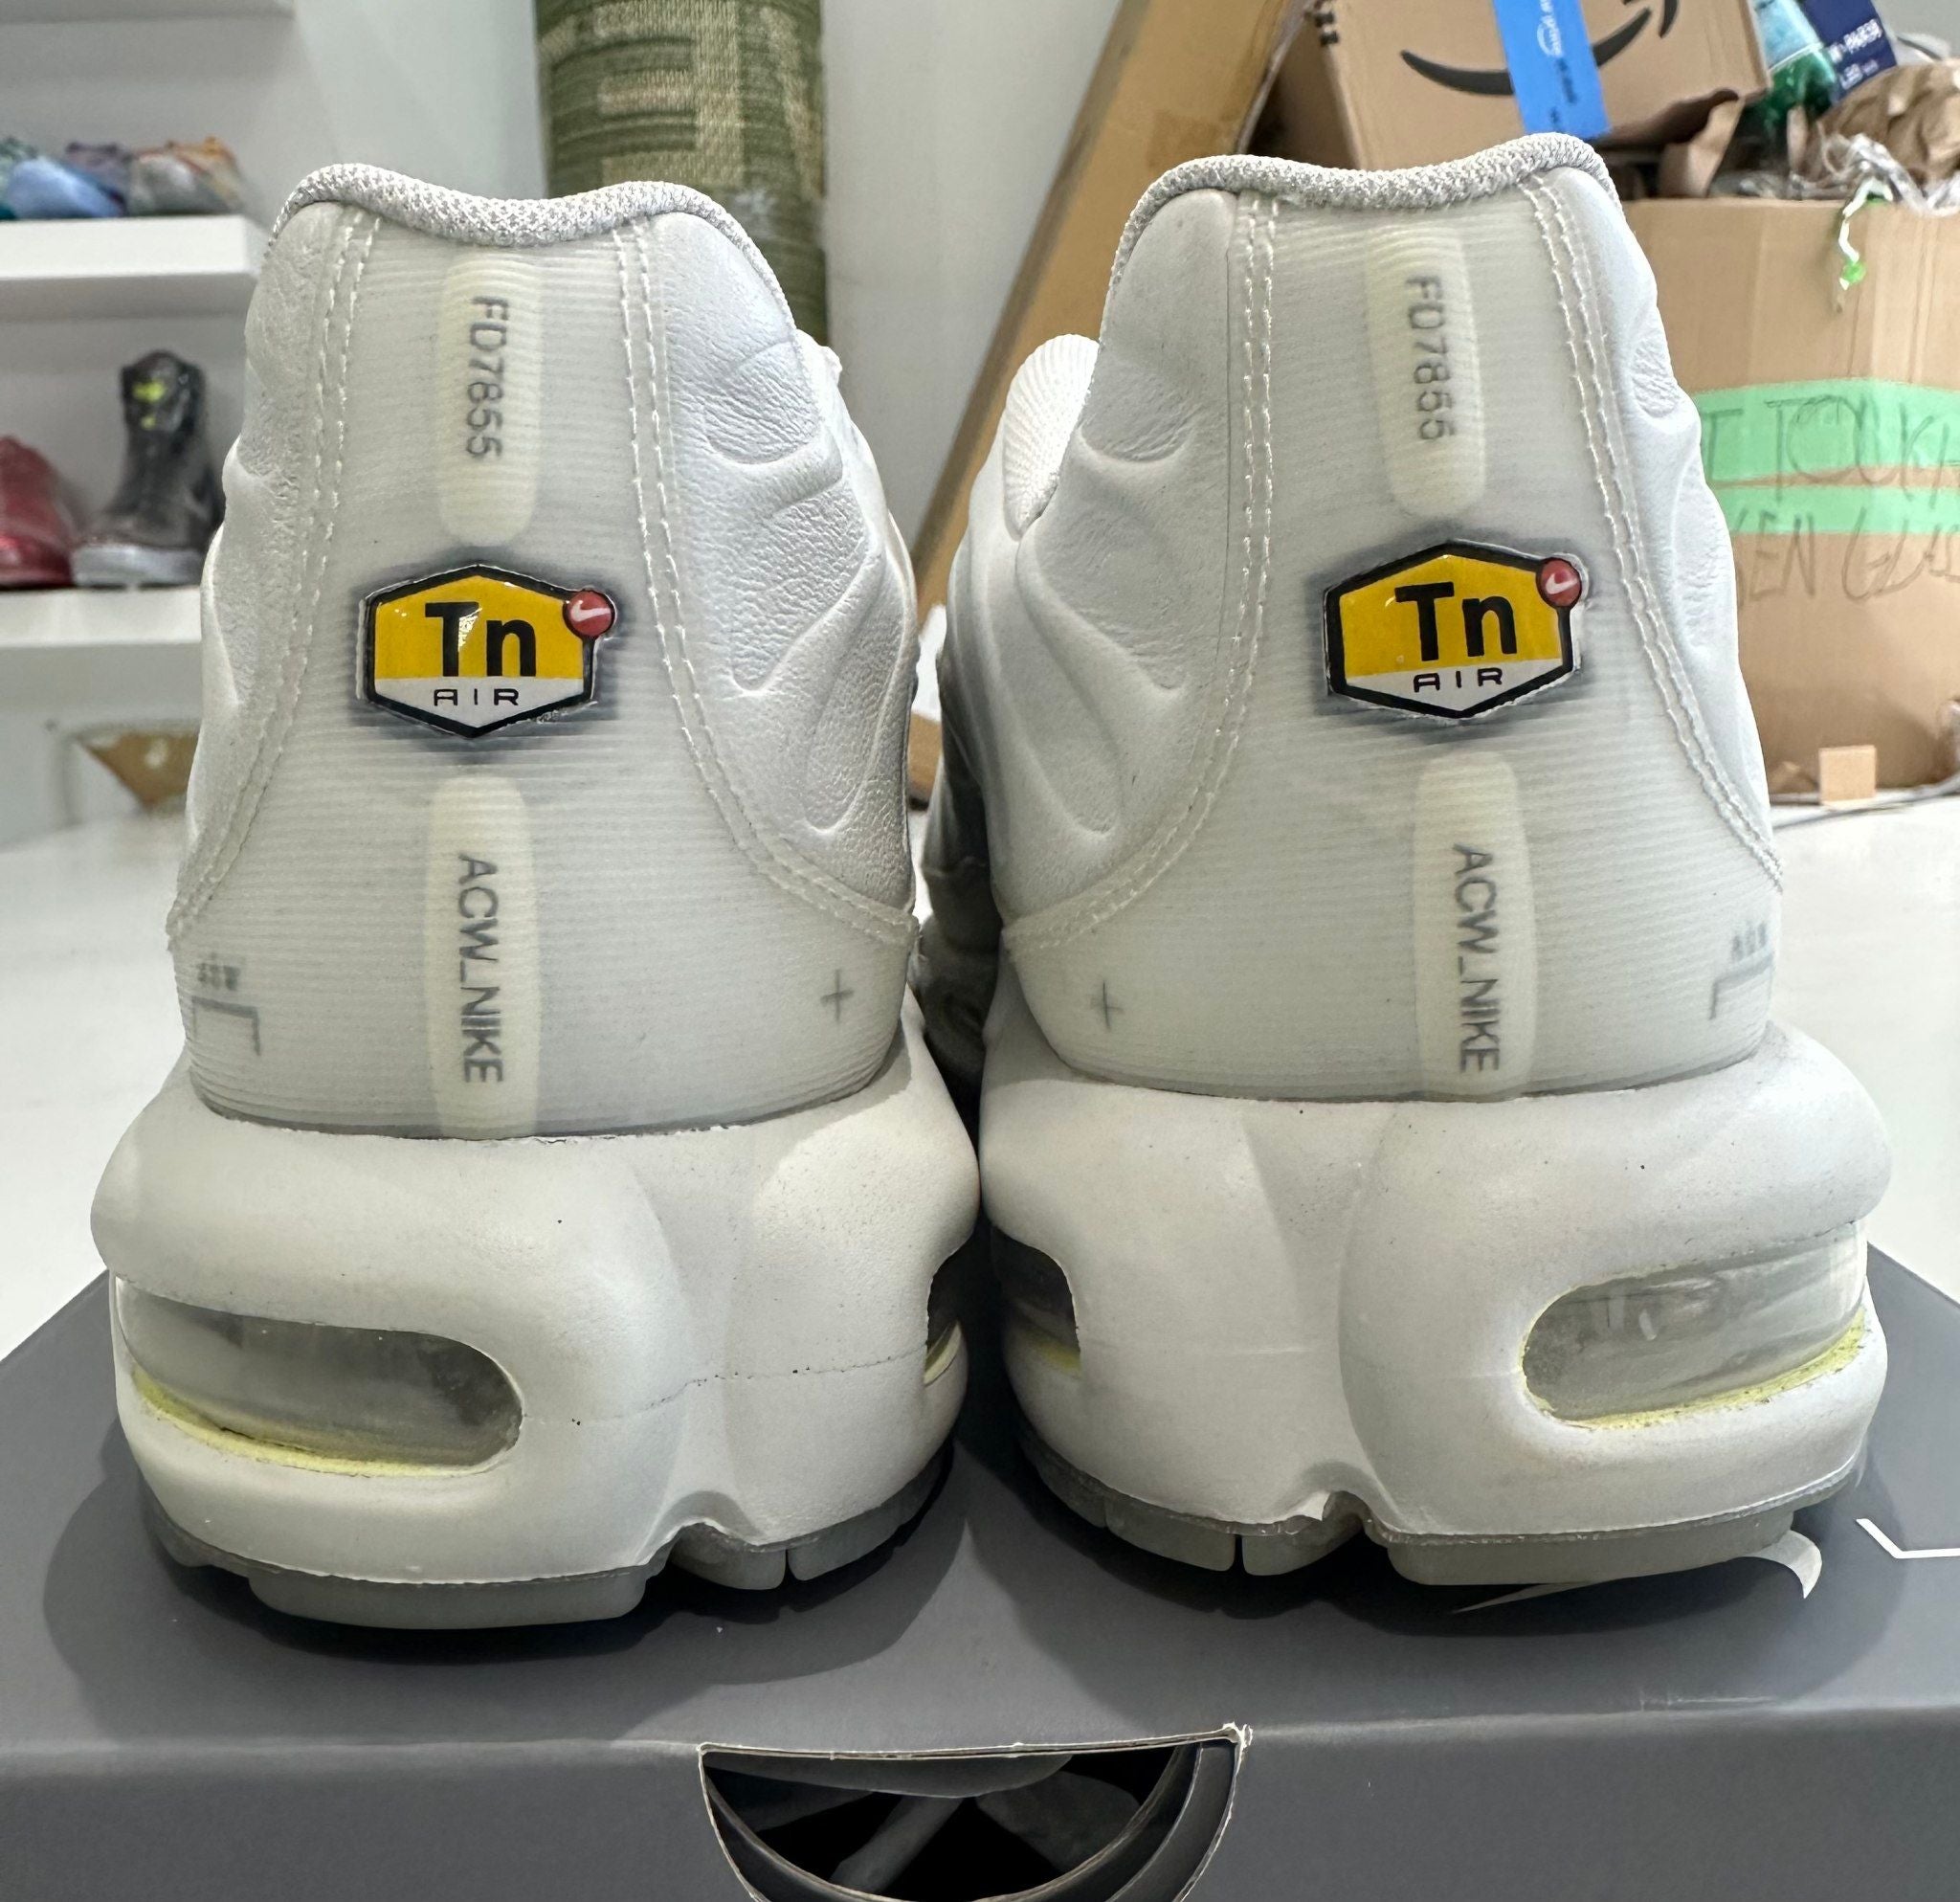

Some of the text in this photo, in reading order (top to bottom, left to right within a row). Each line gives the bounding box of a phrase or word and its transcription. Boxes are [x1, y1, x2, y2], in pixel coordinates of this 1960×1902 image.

[466, 295, 510, 461] FD7855
[425, 601, 537, 677] Tn
[1394, 581, 1518, 662] Tn
[434, 688, 520, 706] AIR
[1413, 667, 1503, 693] AIR
